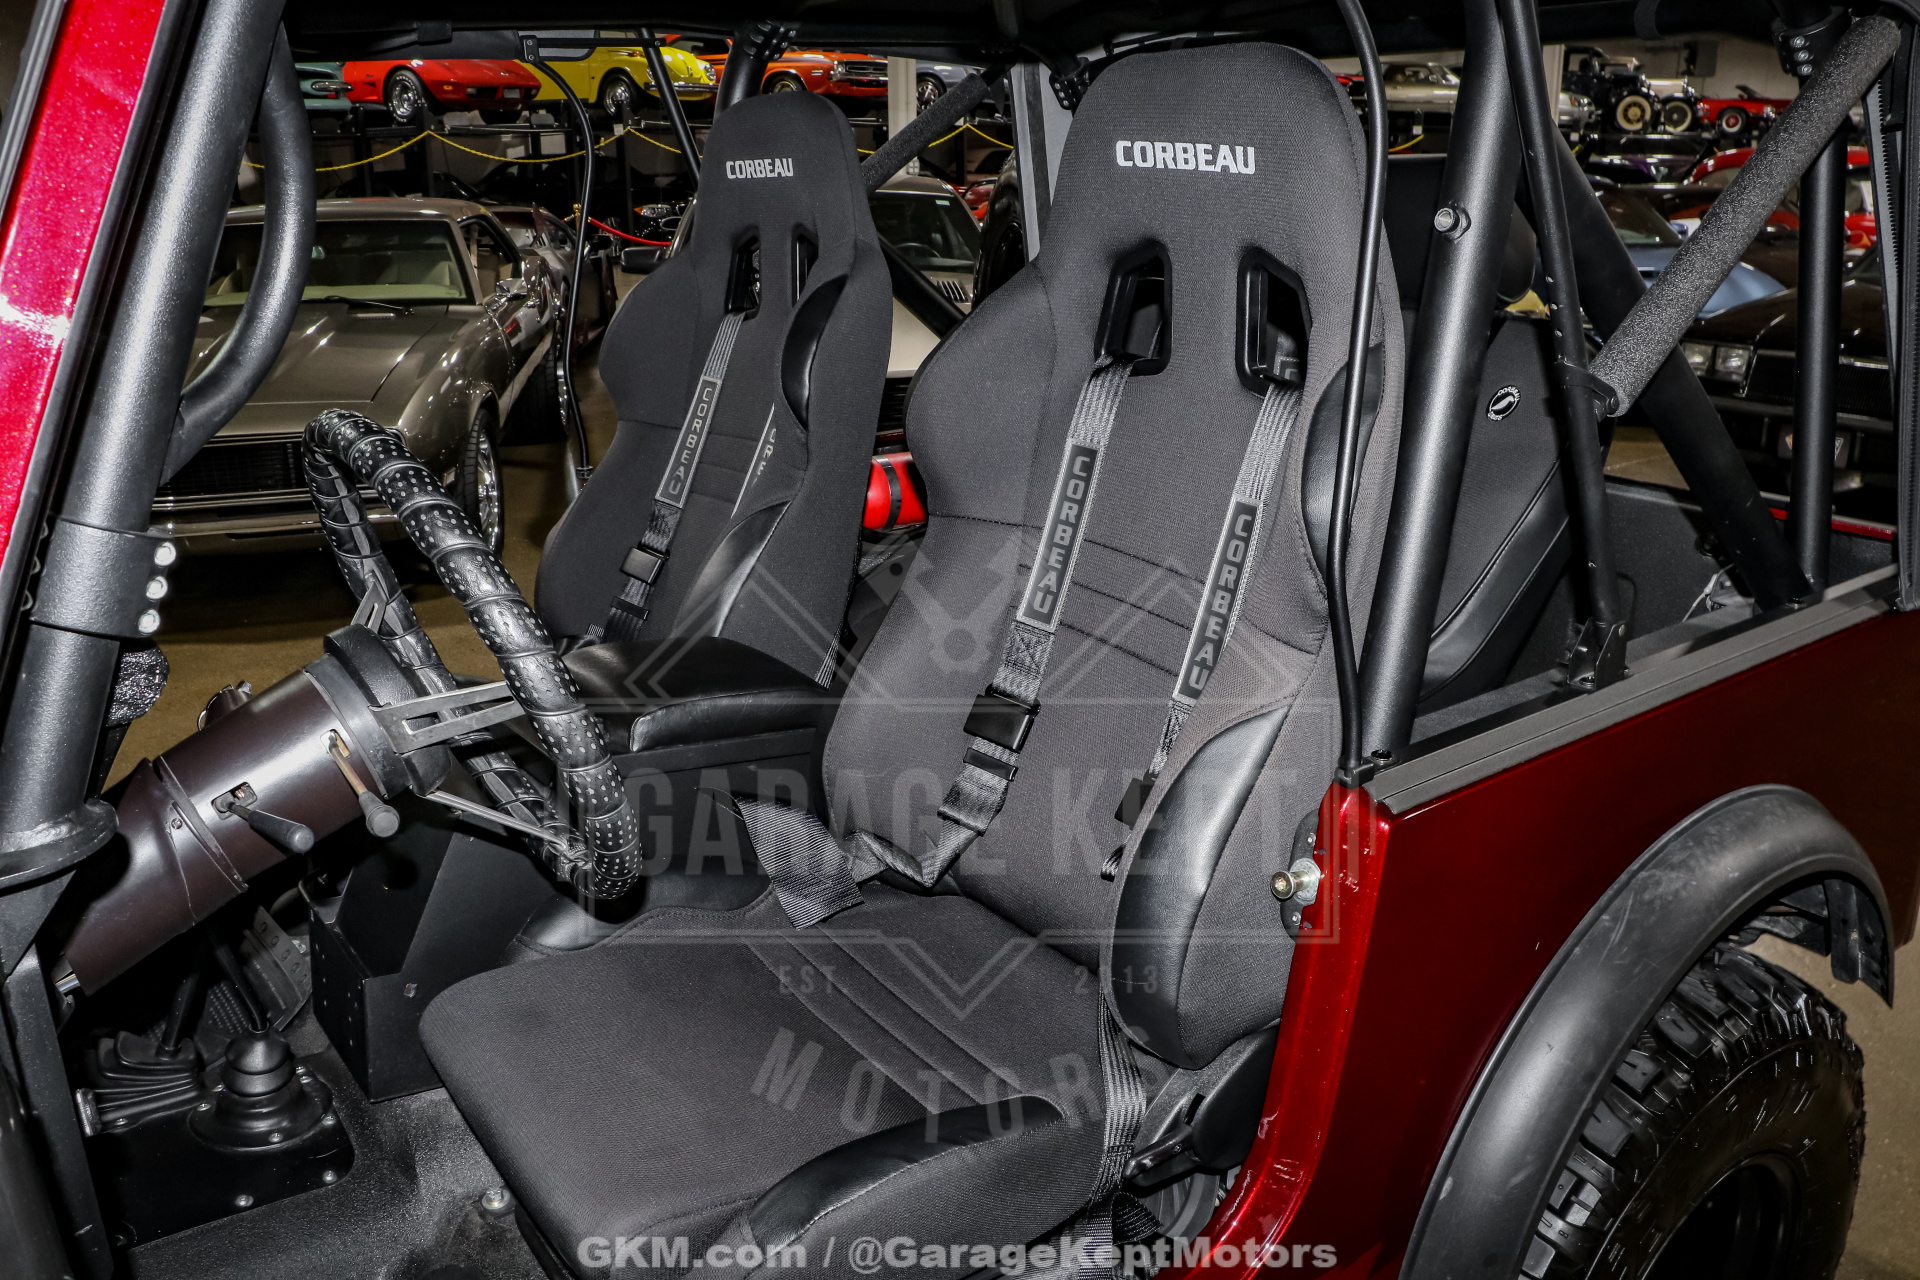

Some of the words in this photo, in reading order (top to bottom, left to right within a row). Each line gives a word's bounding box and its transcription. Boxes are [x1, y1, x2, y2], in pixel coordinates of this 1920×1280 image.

[725, 157, 794, 179] CORBEAU
[1116, 140, 1256, 175] CORBEAU
[668, 387, 713, 495] CORBEAU
[1032, 455, 1091, 614] CORBEAU
[1188, 513, 1252, 691] CORBEAU
